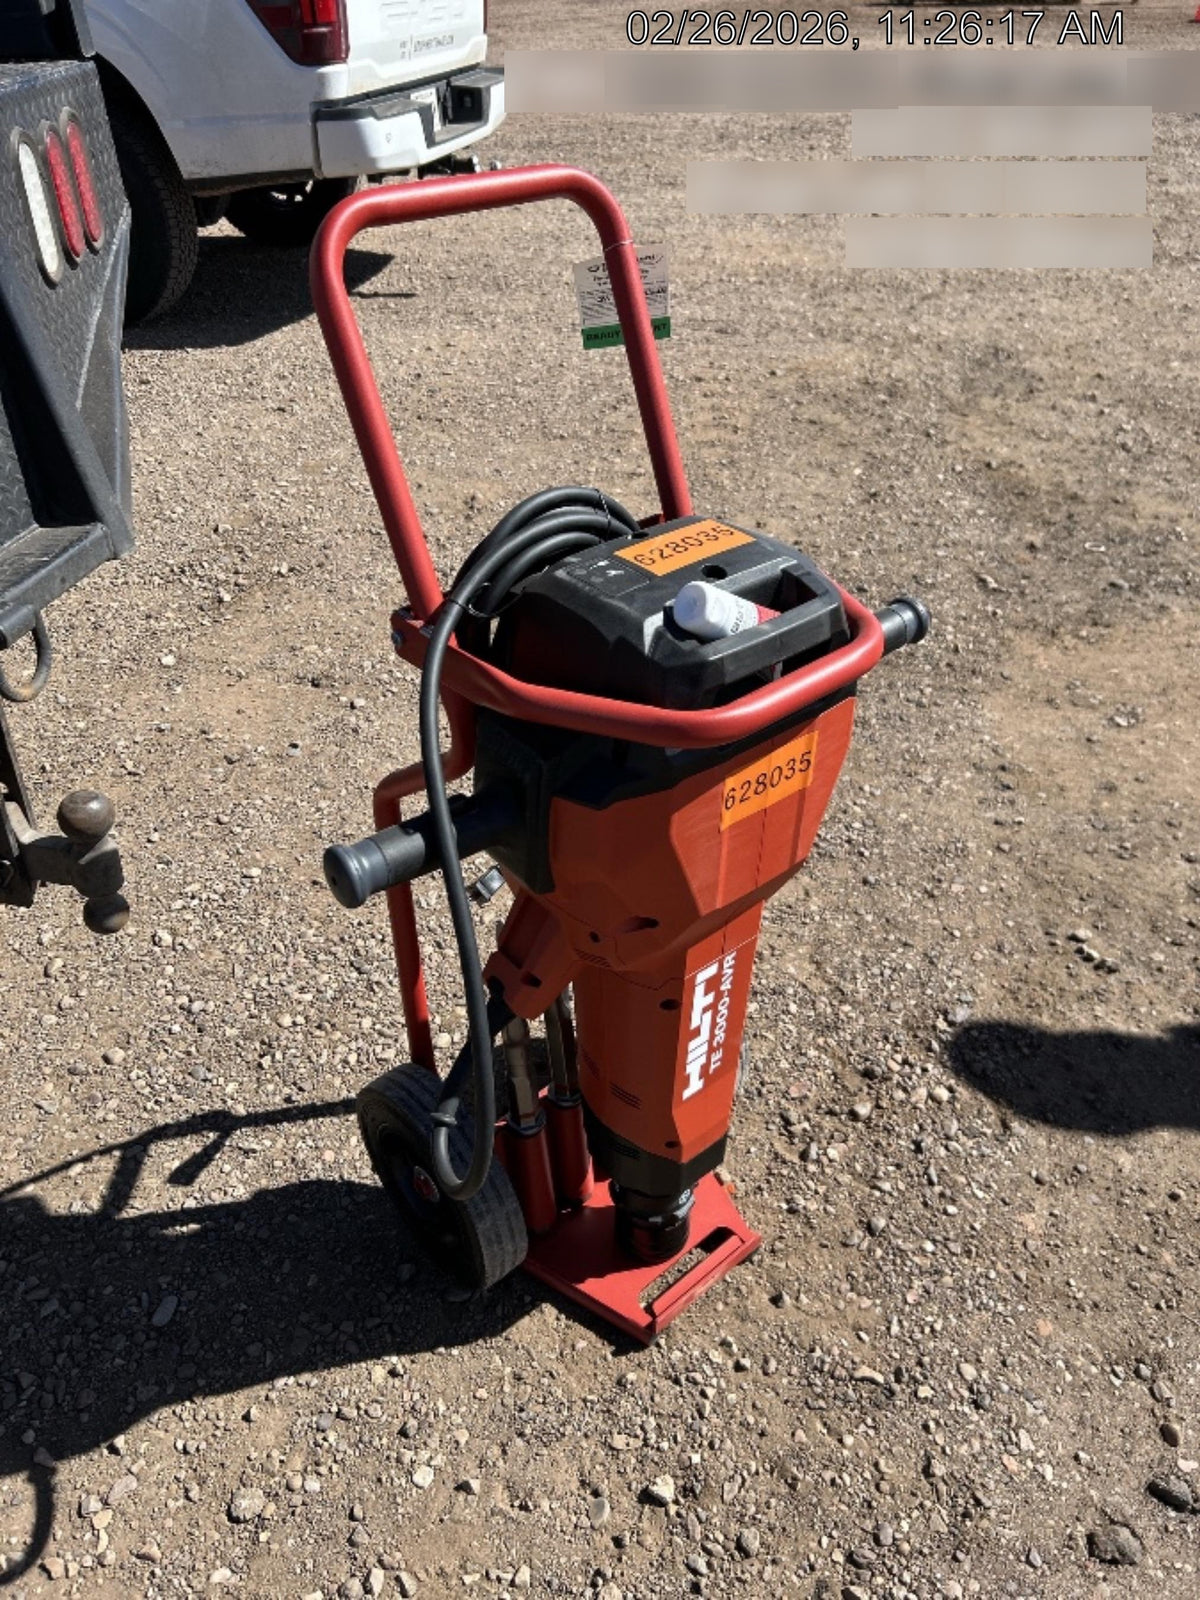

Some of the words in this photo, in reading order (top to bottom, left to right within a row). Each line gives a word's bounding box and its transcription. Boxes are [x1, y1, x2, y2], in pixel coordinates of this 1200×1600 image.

[633, 525, 736, 567] 628035
[724, 749, 812, 811] 628035
[712, 950, 737, 1047] 3000-AVR
[682, 961, 719, 1101] HILTI
[709, 1047, 723, 1075] TE
